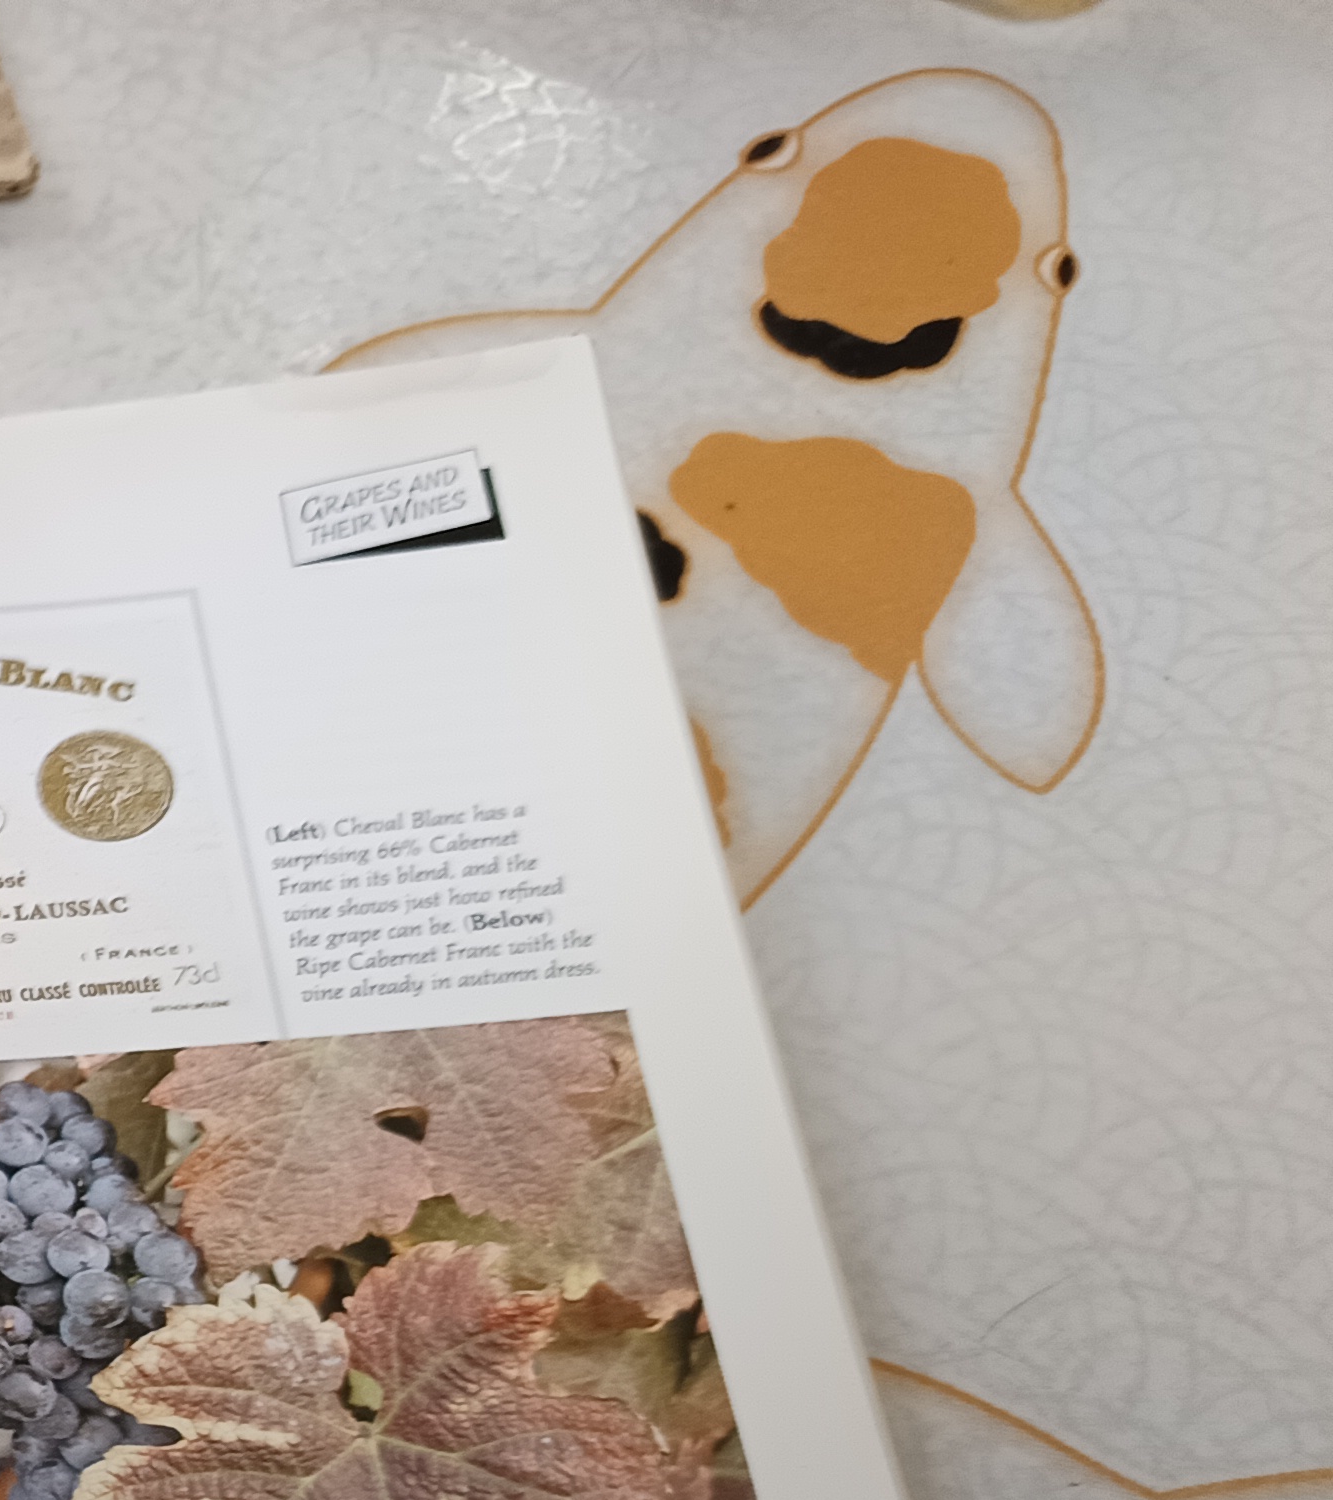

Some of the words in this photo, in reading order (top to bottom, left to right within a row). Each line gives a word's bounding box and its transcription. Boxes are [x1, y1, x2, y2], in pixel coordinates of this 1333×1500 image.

[300, 478, 402, 524] GRAPES
[409, 466, 460, 495] AND
[305, 513, 376, 547] THEIR
[381, 489, 467, 529] WINES
[265, 820, 327, 844] (Left)
[333, 811, 404, 838] Cheval
[411, 809, 466, 830] Blanc
[472, 803, 508, 822] has
[512, 805, 527, 819] a
[271, 848, 371, 872] surprising
[376, 838, 422, 860] 66%
[428, 830, 520, 855] Cabernet
[289, 928, 321, 949] the
[324, 928, 382, 951] grape
[387, 924, 423, 940] can
[428, 916, 456, 936] be.
[464, 909, 552, 932] (Below)
[19, 981, 72, 1002] CLASSÉ
[78, 976, 162, 999] CONTROLÉE
